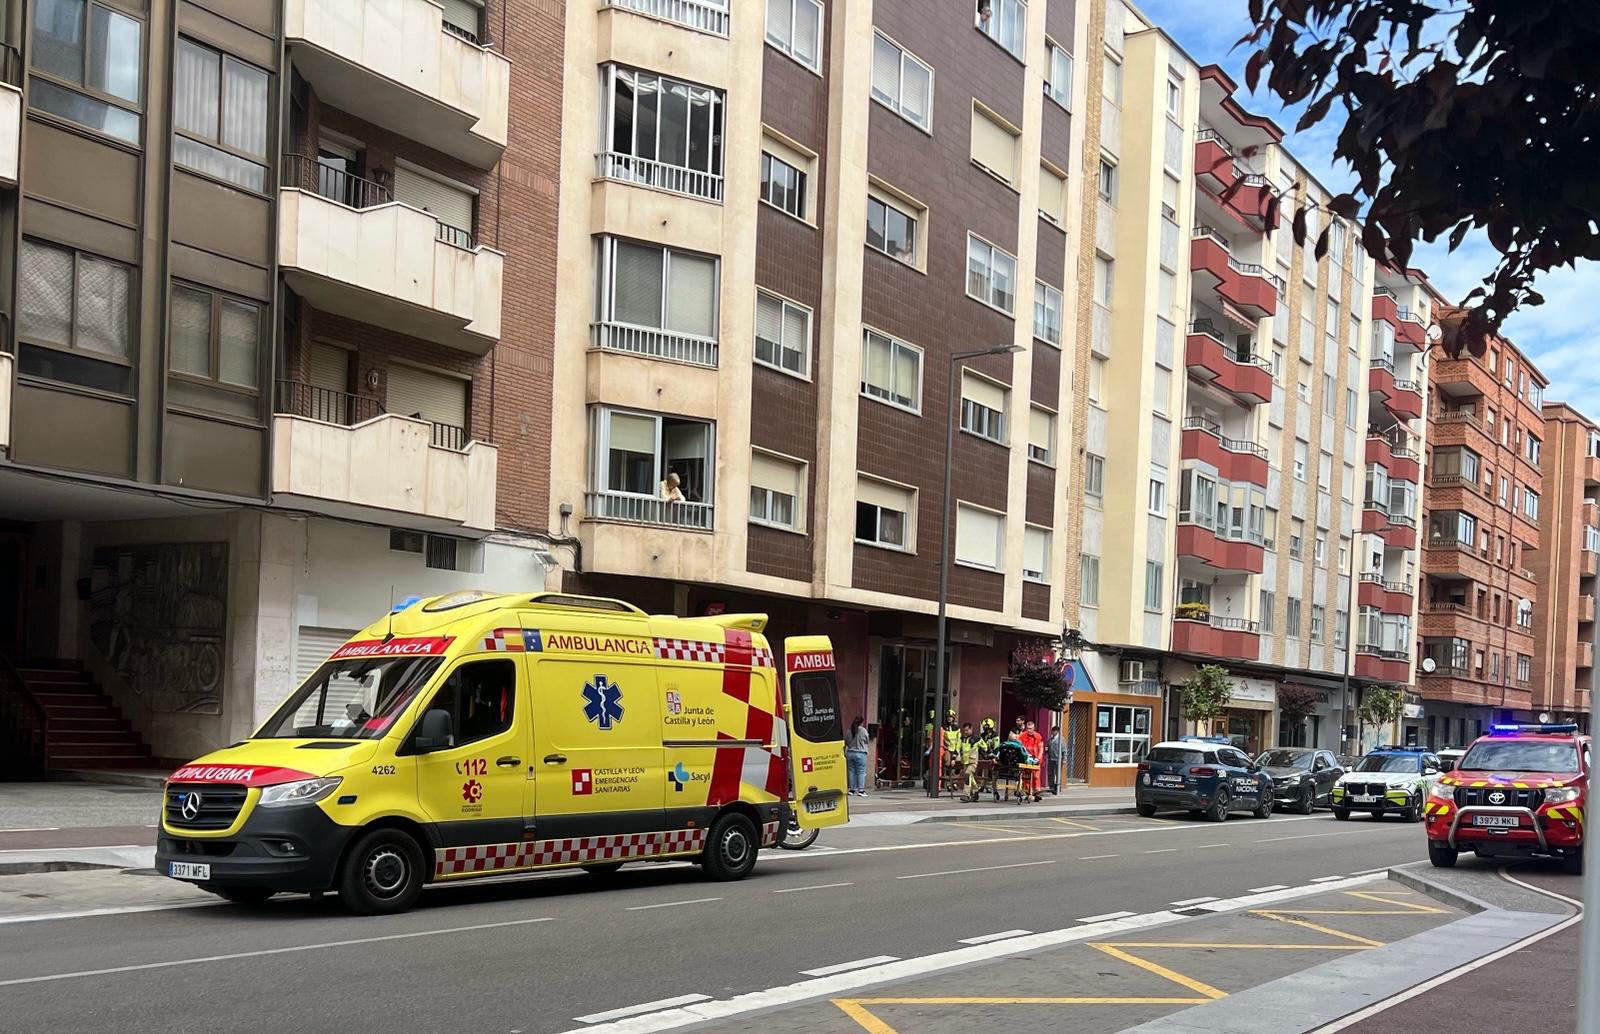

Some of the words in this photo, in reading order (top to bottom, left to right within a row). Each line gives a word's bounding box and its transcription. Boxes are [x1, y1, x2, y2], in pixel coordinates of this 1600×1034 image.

[547, 634, 651, 654] AMBULANCIA
[338, 643, 432, 657] AMBULANCIA
[794, 653, 835, 669] AMBUL
[705, 707, 714, 715] de
[664, 716, 690, 725] Castilla
[691, 719, 696, 727] y
[698, 716, 715, 725] León
[371, 765, 396, 775] 4262
[464, 758, 487, 776] 112
[595, 776, 638, 784] EMERGENCIAS
[691, 771, 710, 783] Sacyl
[594, 785, 631, 793] SANITARIAS
[1479, 816, 1500, 825] 3973
[1501, 817, 1517, 826] MKL
[174, 864, 190, 876] 3371
[192, 865, 208, 878] MFL
